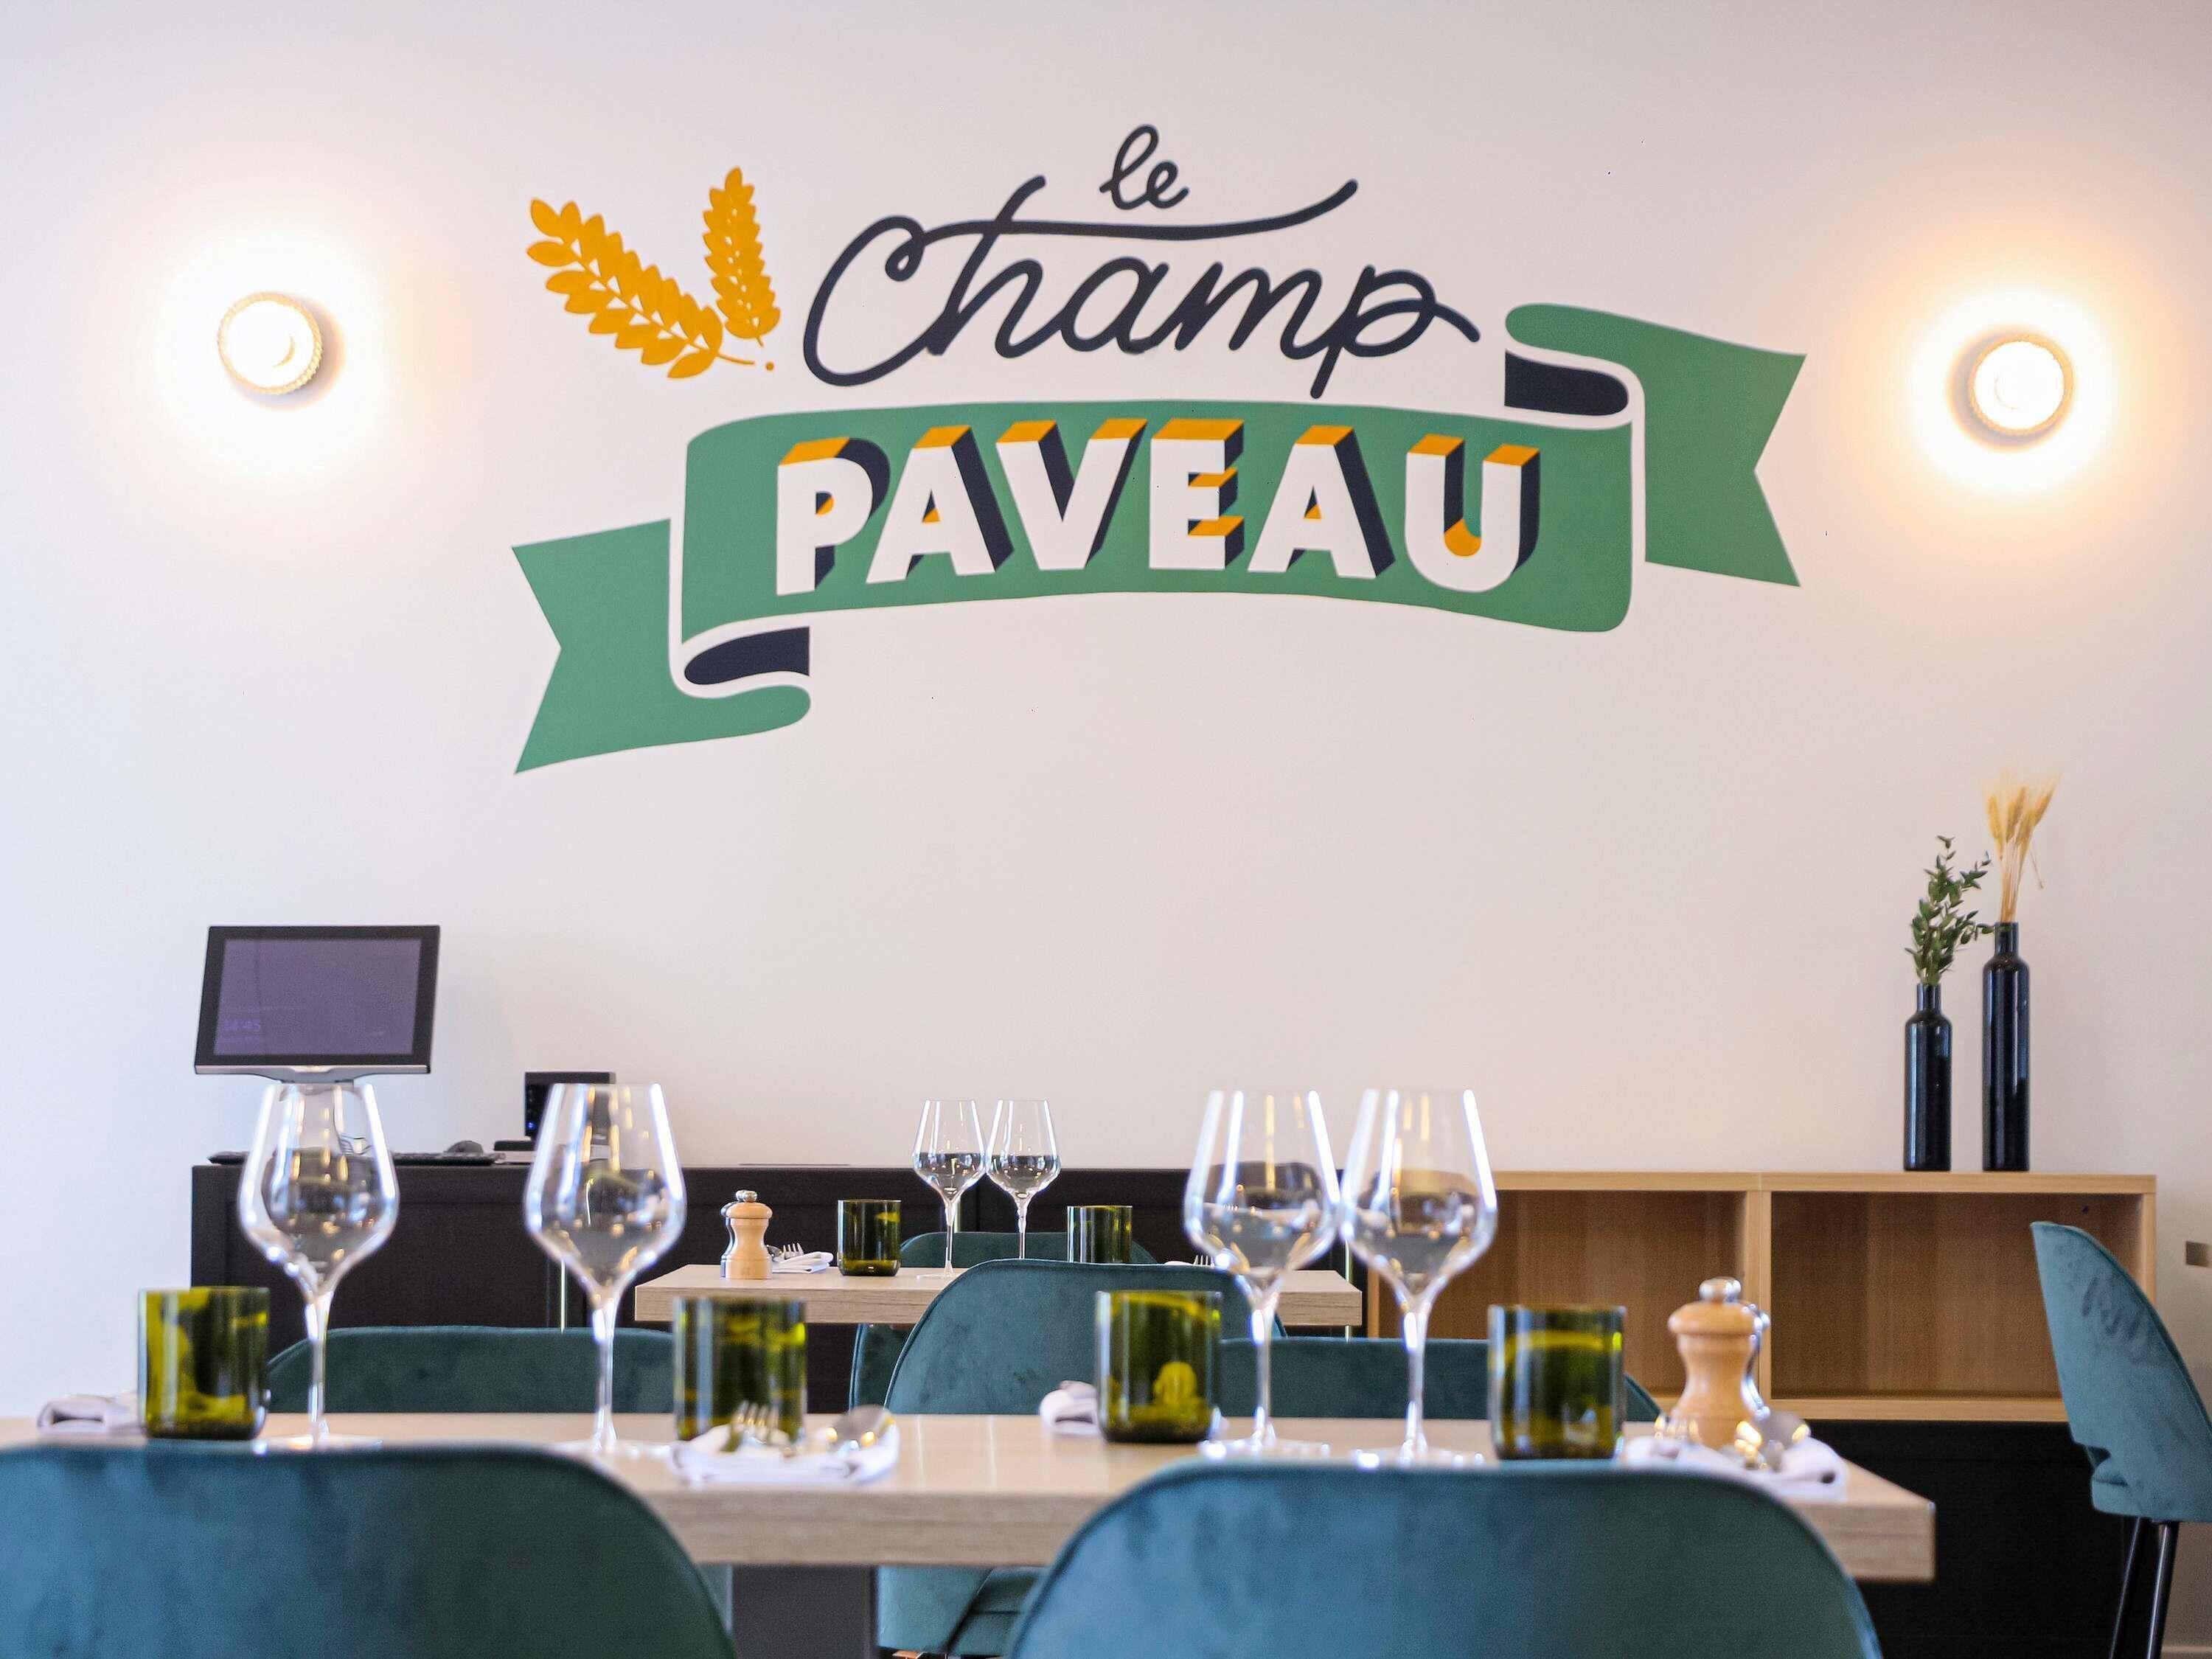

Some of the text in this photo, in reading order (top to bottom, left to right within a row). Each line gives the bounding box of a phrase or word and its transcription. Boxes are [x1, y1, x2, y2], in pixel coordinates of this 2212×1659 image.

[1099, 125, 1189, 210] le
[803, 175, 1481, 400] Champ
[776, 417, 1540, 597] PAVEAU
